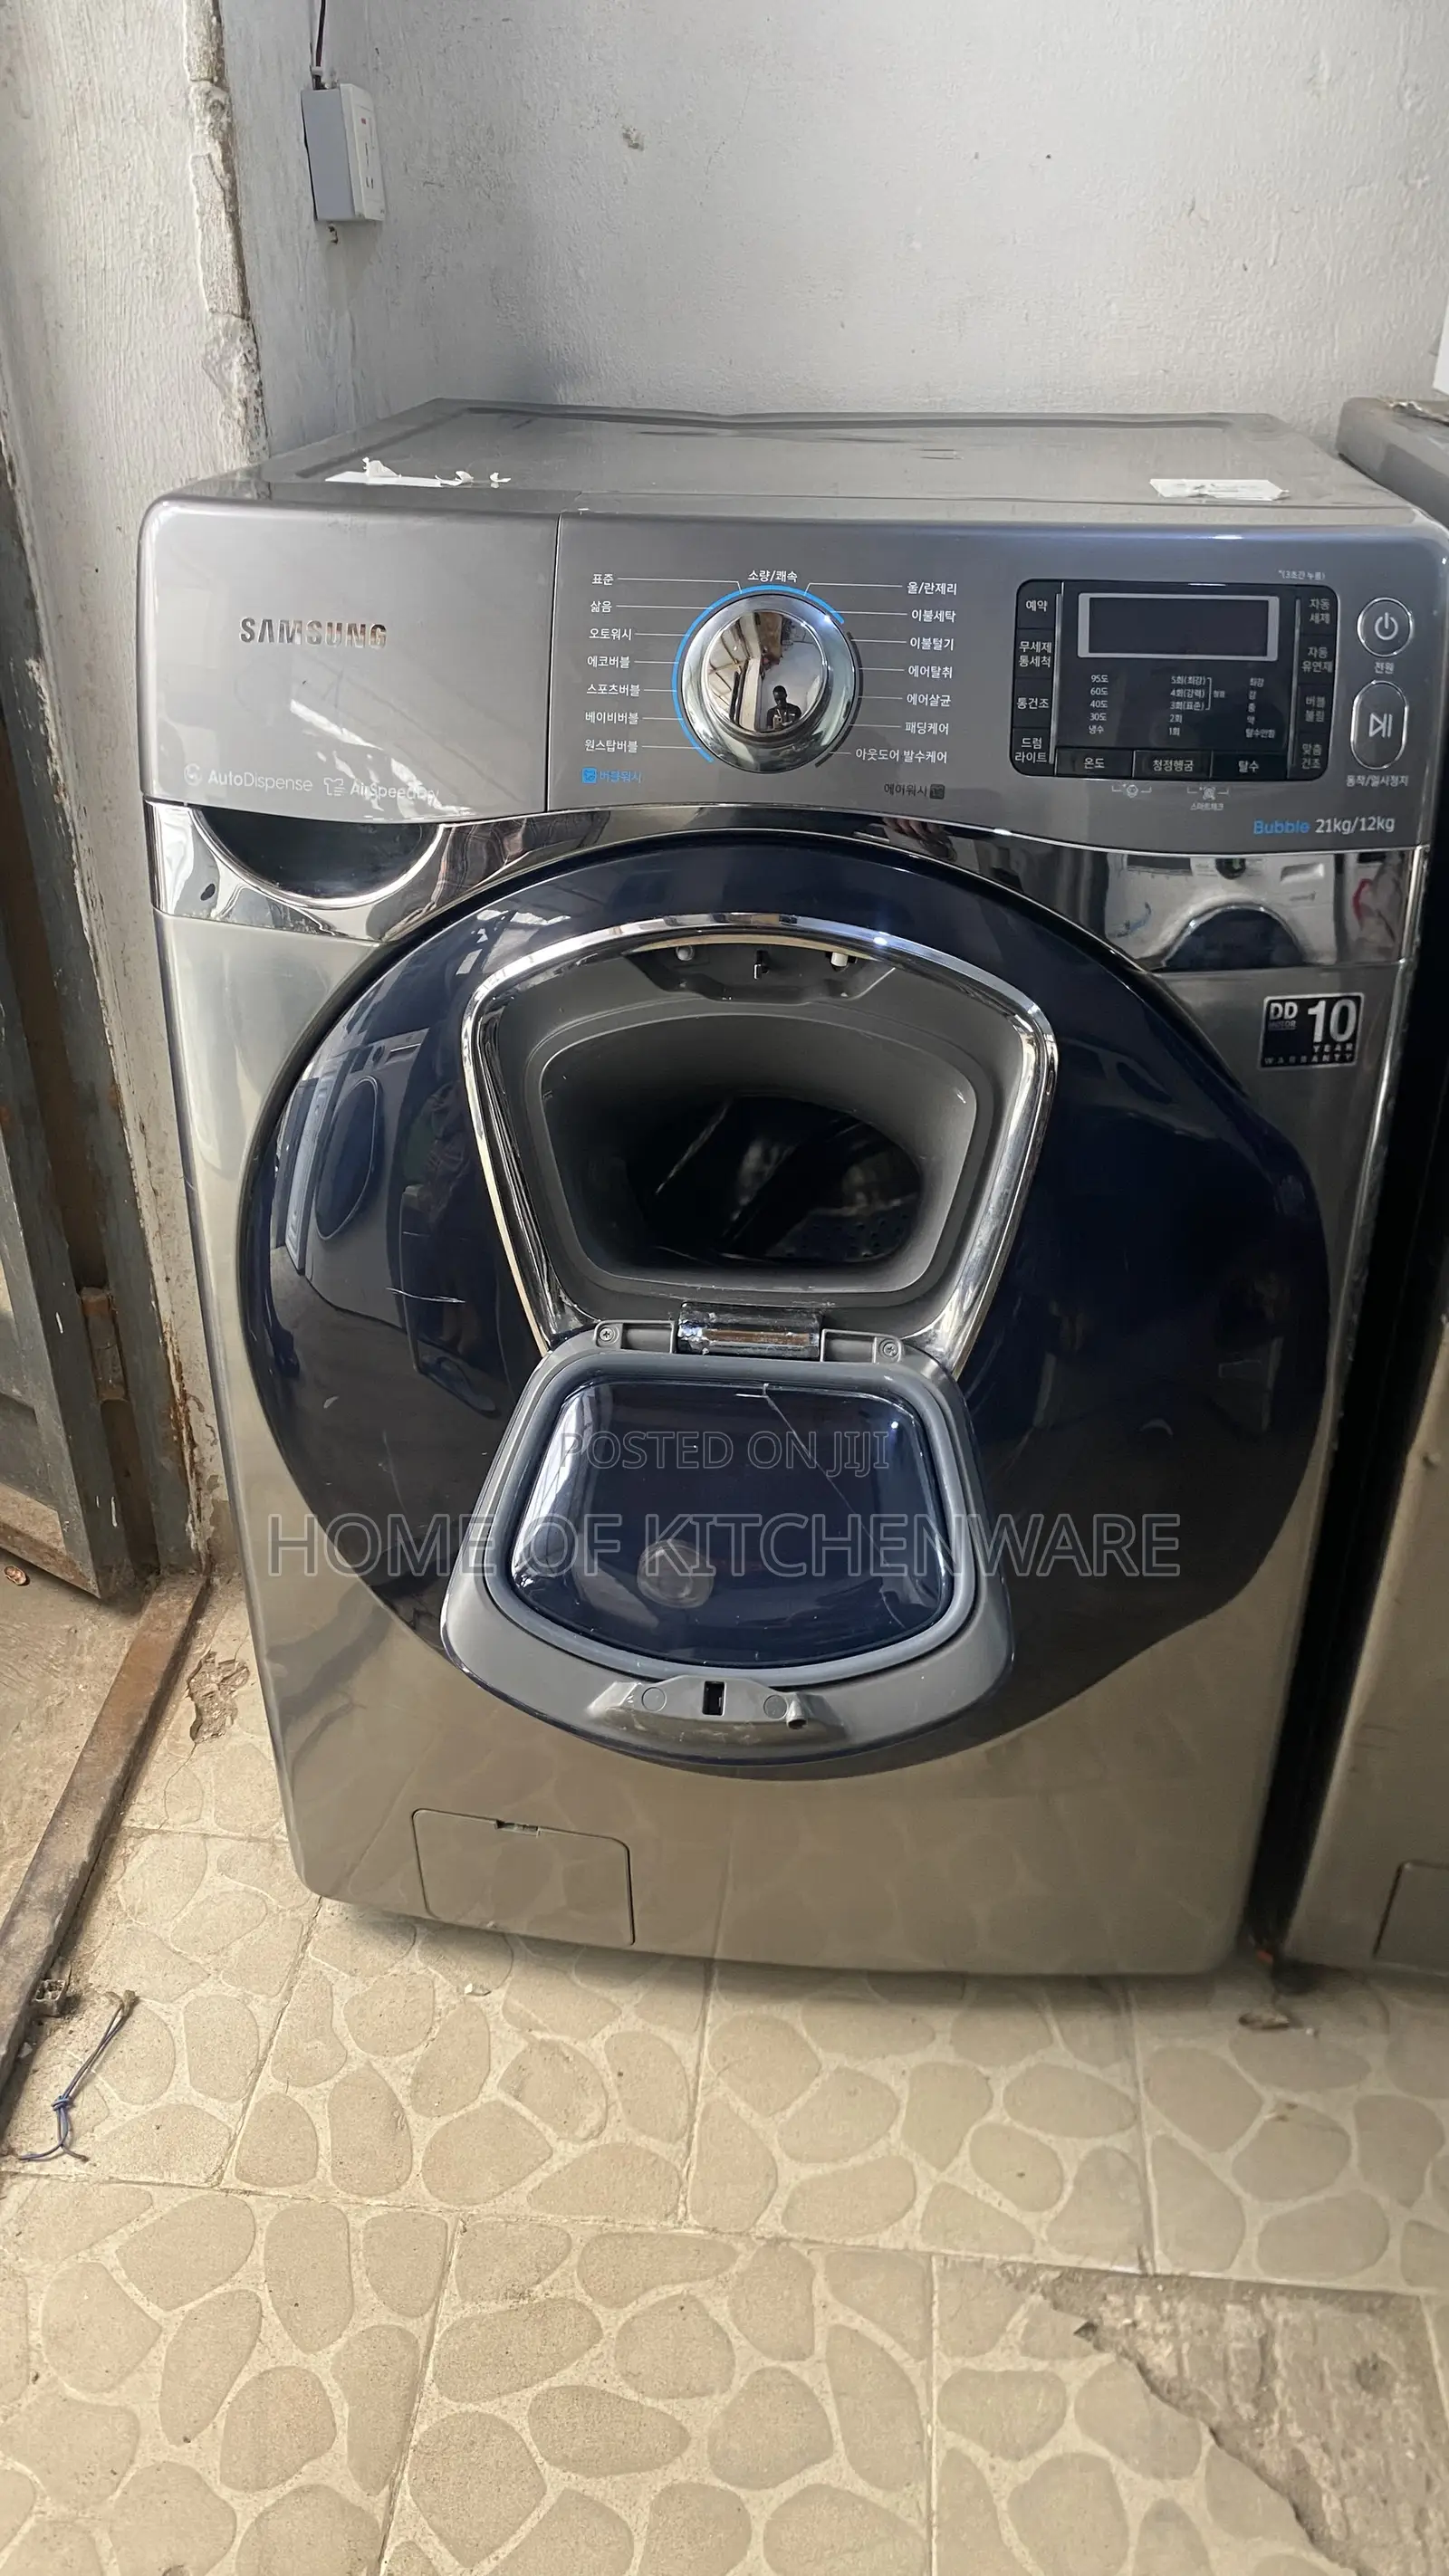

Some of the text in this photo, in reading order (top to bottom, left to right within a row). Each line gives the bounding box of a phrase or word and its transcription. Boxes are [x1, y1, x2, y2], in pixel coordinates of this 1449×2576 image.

[591, 573, 614, 586] 표준
[747, 570, 798, 583] 소량/쾌속
[907, 581, 957, 595] 울/란제리
[590, 601, 612, 613] 삶음
[1025, 599, 1048, 612] 예약
[1309, 599, 1330, 610] 자동
[911, 609, 956, 623] 이불세탁
[1310, 613, 1330, 625] 세제
[239, 617, 388, 649] SAMSUNG
[589, 628, 632, 640] 오토워시
[909, 637, 955, 651] 이불털기
[1019, 641, 1052, 654] 무세제
[1308, 646, 1328, 659] 자동
[588, 656, 629, 669] 에코버블
[1018, 656, 1051, 668] 통세척
[1375, 662, 1395, 675] 전원
[907, 665, 954, 679] 에어탈취
[1090, 675, 1108, 684] 95도
[586, 684, 640, 697] 스포츠버블
[1089, 687, 1108, 696] 60도
[907, 694, 951, 707] 에어살균
[1016, 697, 1050, 710] 통건조
[1089, 700, 1108, 709] 40도
[1306, 696, 1326, 708] 버블
[585, 711, 639, 725] 베이비버블
[1089, 713, 1107, 722] 30도
[1169, 713, 1182, 723] 2회
[905, 722, 949, 735] 패딩케어
[1089, 725, 1104, 734] 냉수
[1169, 726, 1180, 737] 1회
[584, 739, 638, 753] 원스탑버블
[1022, 737, 1041, 750] 드럼
[1302, 743, 1322, 756] 맞춤
[855, 748, 947, 763] 아웃도어 발수케어
[1014, 752, 1047, 763] 라이트
[1083, 757, 1105, 770] 온도
[1153, 759, 1194, 772] 청정헹굼
[1238, 760, 1260, 773] 탈수
[1301, 758, 1321, 770] 건조
[207, 770, 312, 791] AutoDispense
[884, 783, 927, 797] 에어워시
[1253, 816, 1396, 836] Bubble 21kg/12kg
[1269, 1001, 1299, 1020] DD
[1307, 999, 1357, 1043] 10
[1312, 1043, 1353, 1053] YEAR
[1264, 1053, 1352, 1065] WARRANTY
